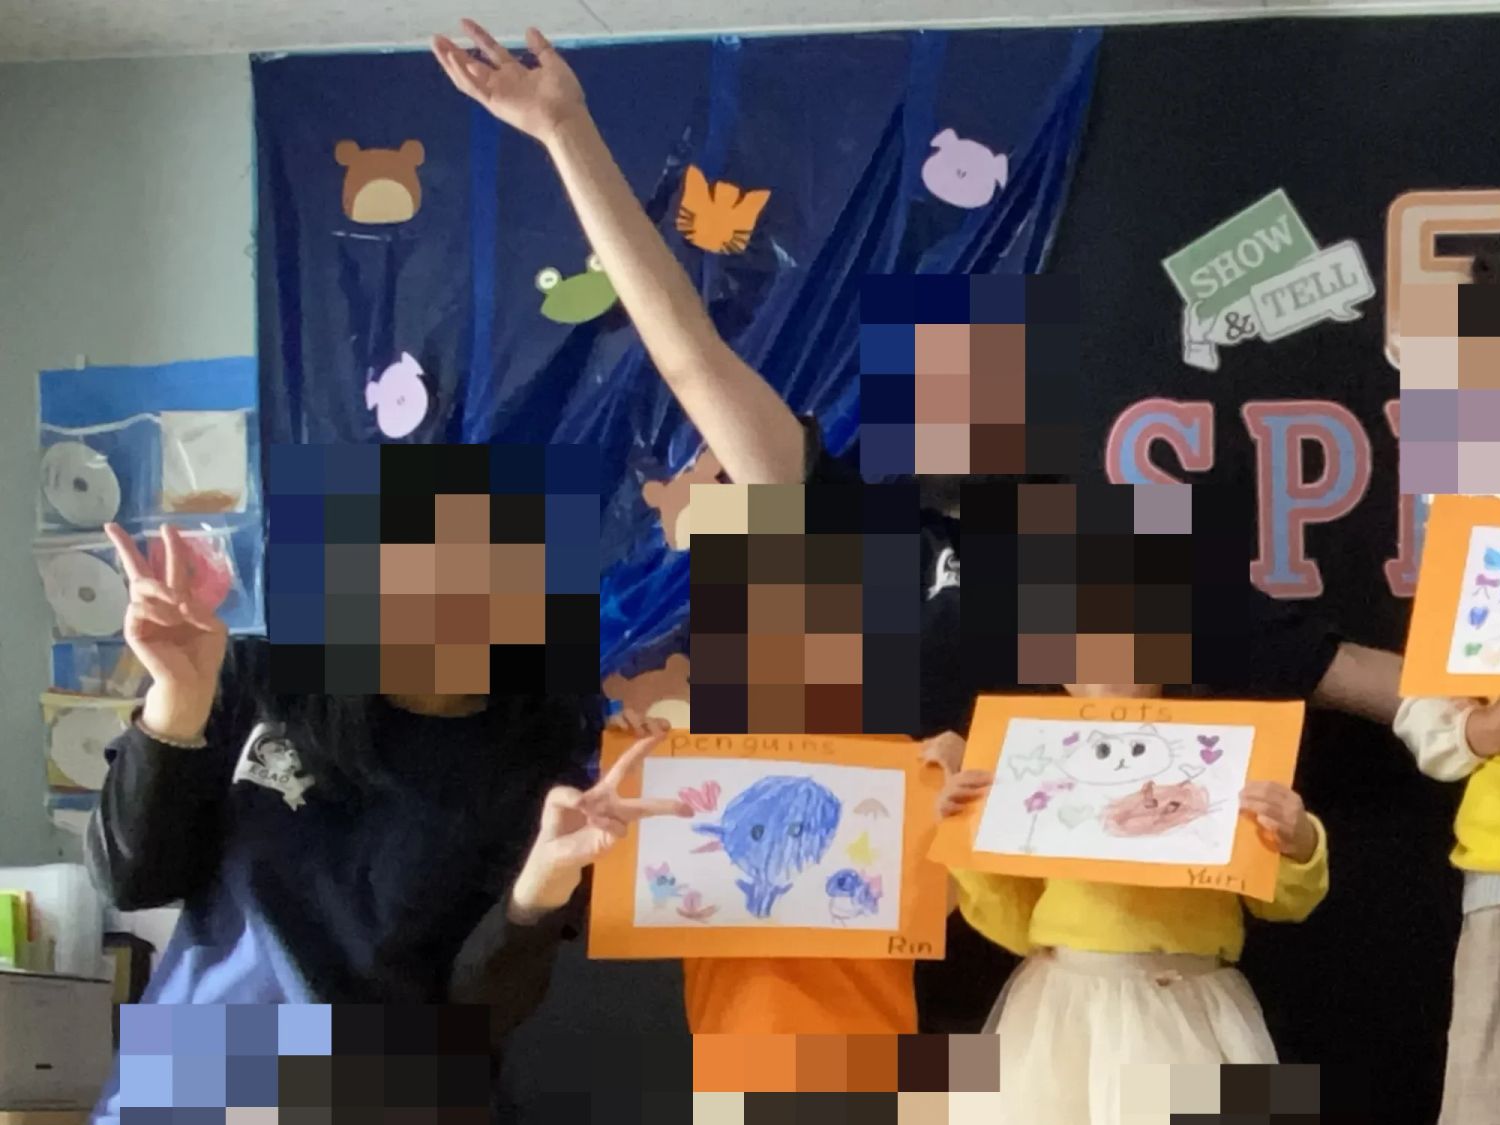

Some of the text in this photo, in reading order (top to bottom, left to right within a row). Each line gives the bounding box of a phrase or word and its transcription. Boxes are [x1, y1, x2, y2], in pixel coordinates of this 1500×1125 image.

[1189, 214, 1294, 299] SHOW
[1223, 261, 1359, 341] & TELL
[1079, 702, 1173, 722] cats
[670, 734, 836, 757] penguins
[887, 935, 933, 955] Rin
